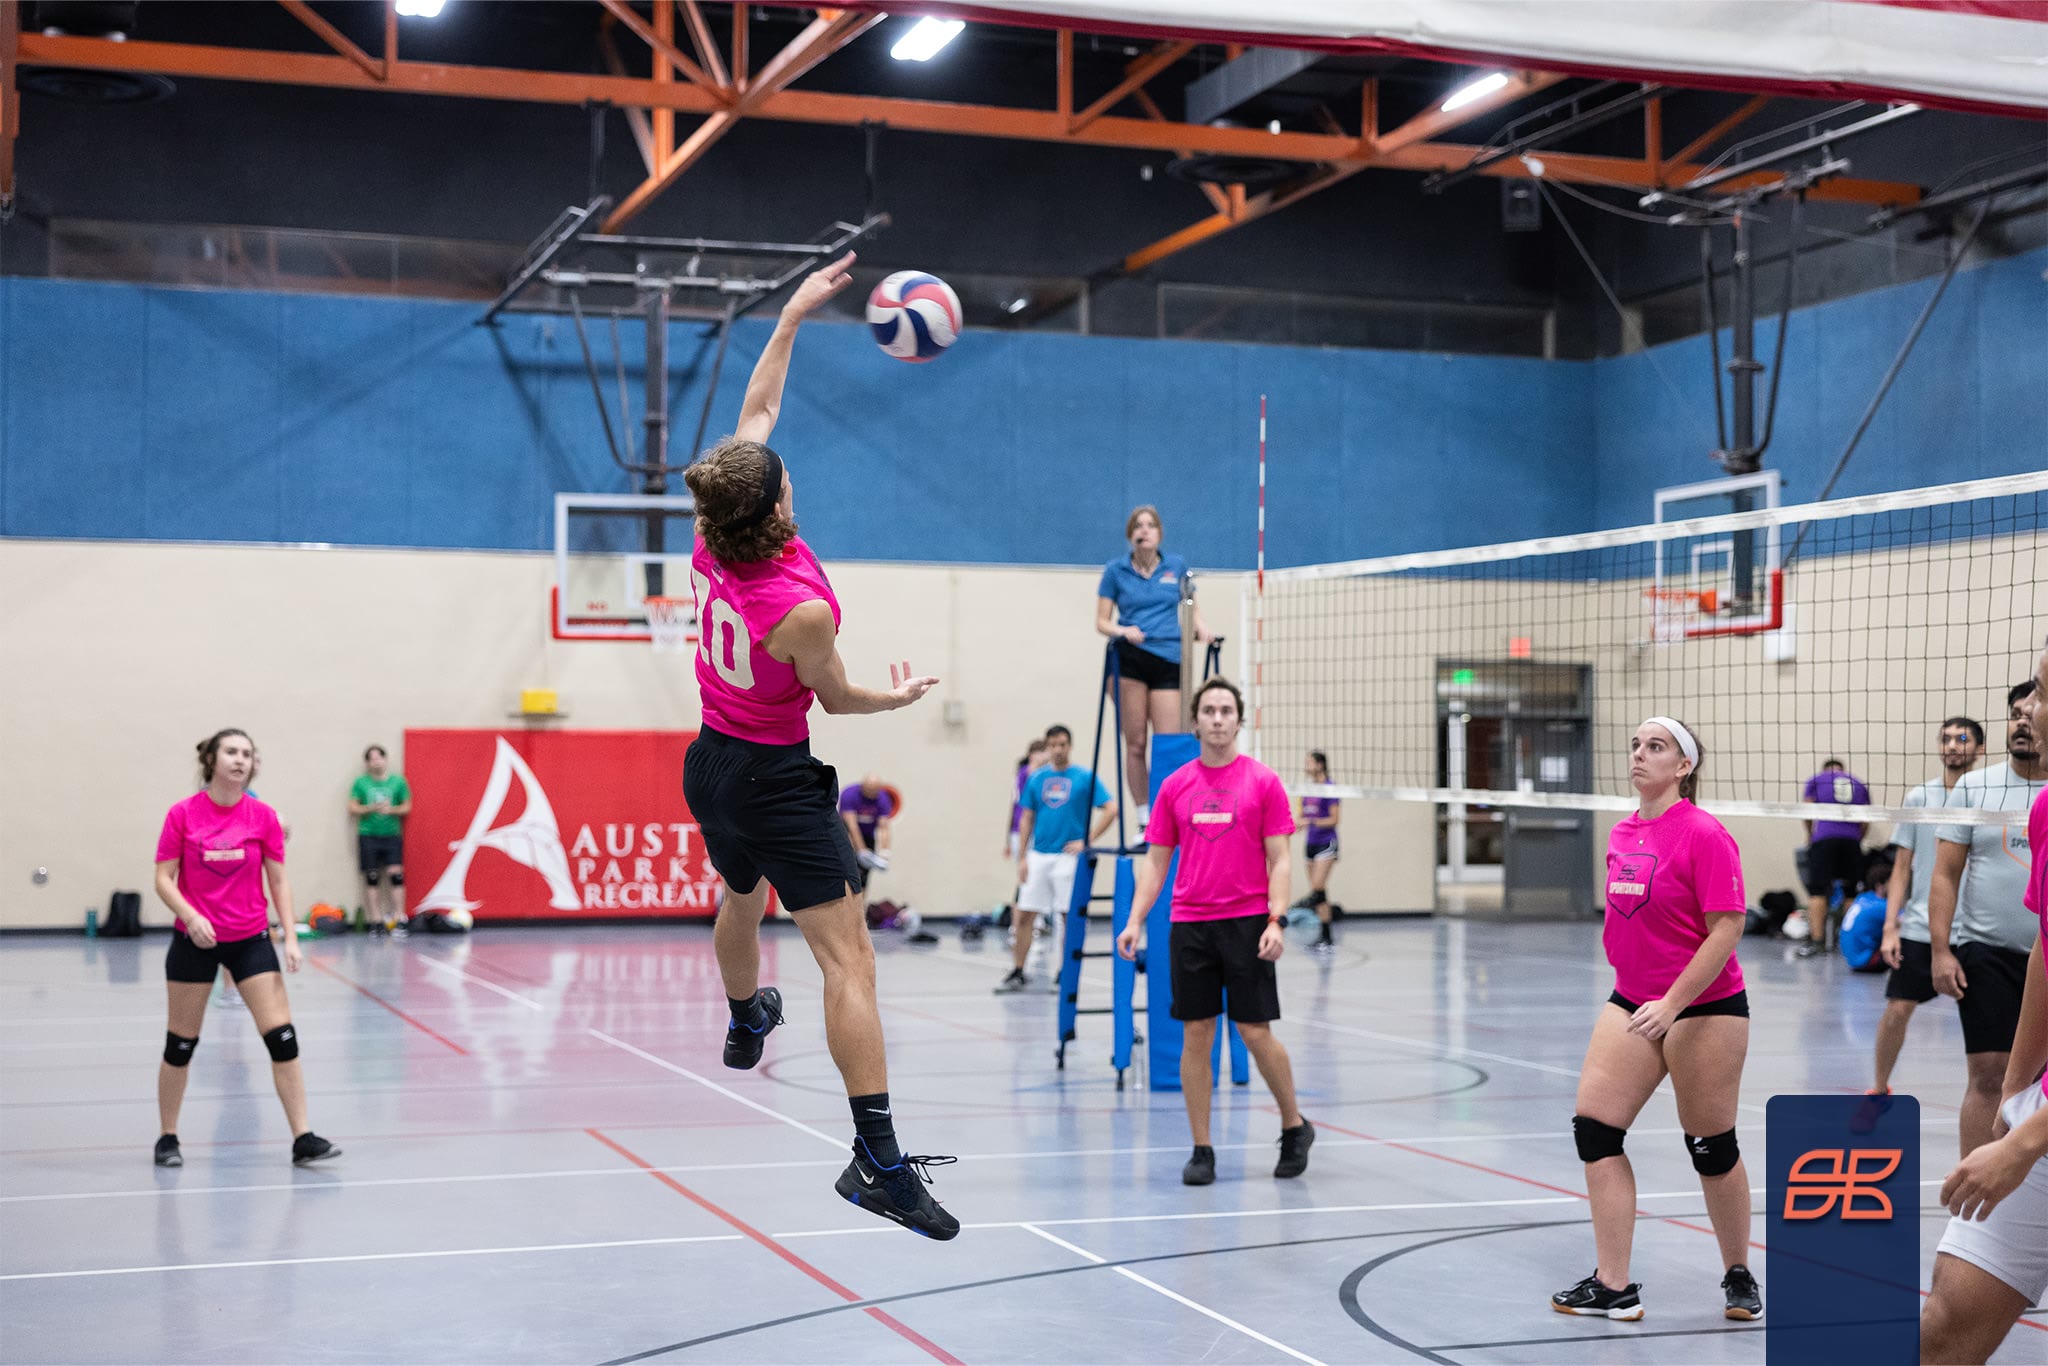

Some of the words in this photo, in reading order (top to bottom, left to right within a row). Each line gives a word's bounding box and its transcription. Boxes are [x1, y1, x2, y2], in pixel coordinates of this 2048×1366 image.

[692, 567, 755, 690] 10
[571, 823, 700, 857] AUST
[2011, 838, 2029, 848] SPO
[577, 857, 718, 883] PARKS
